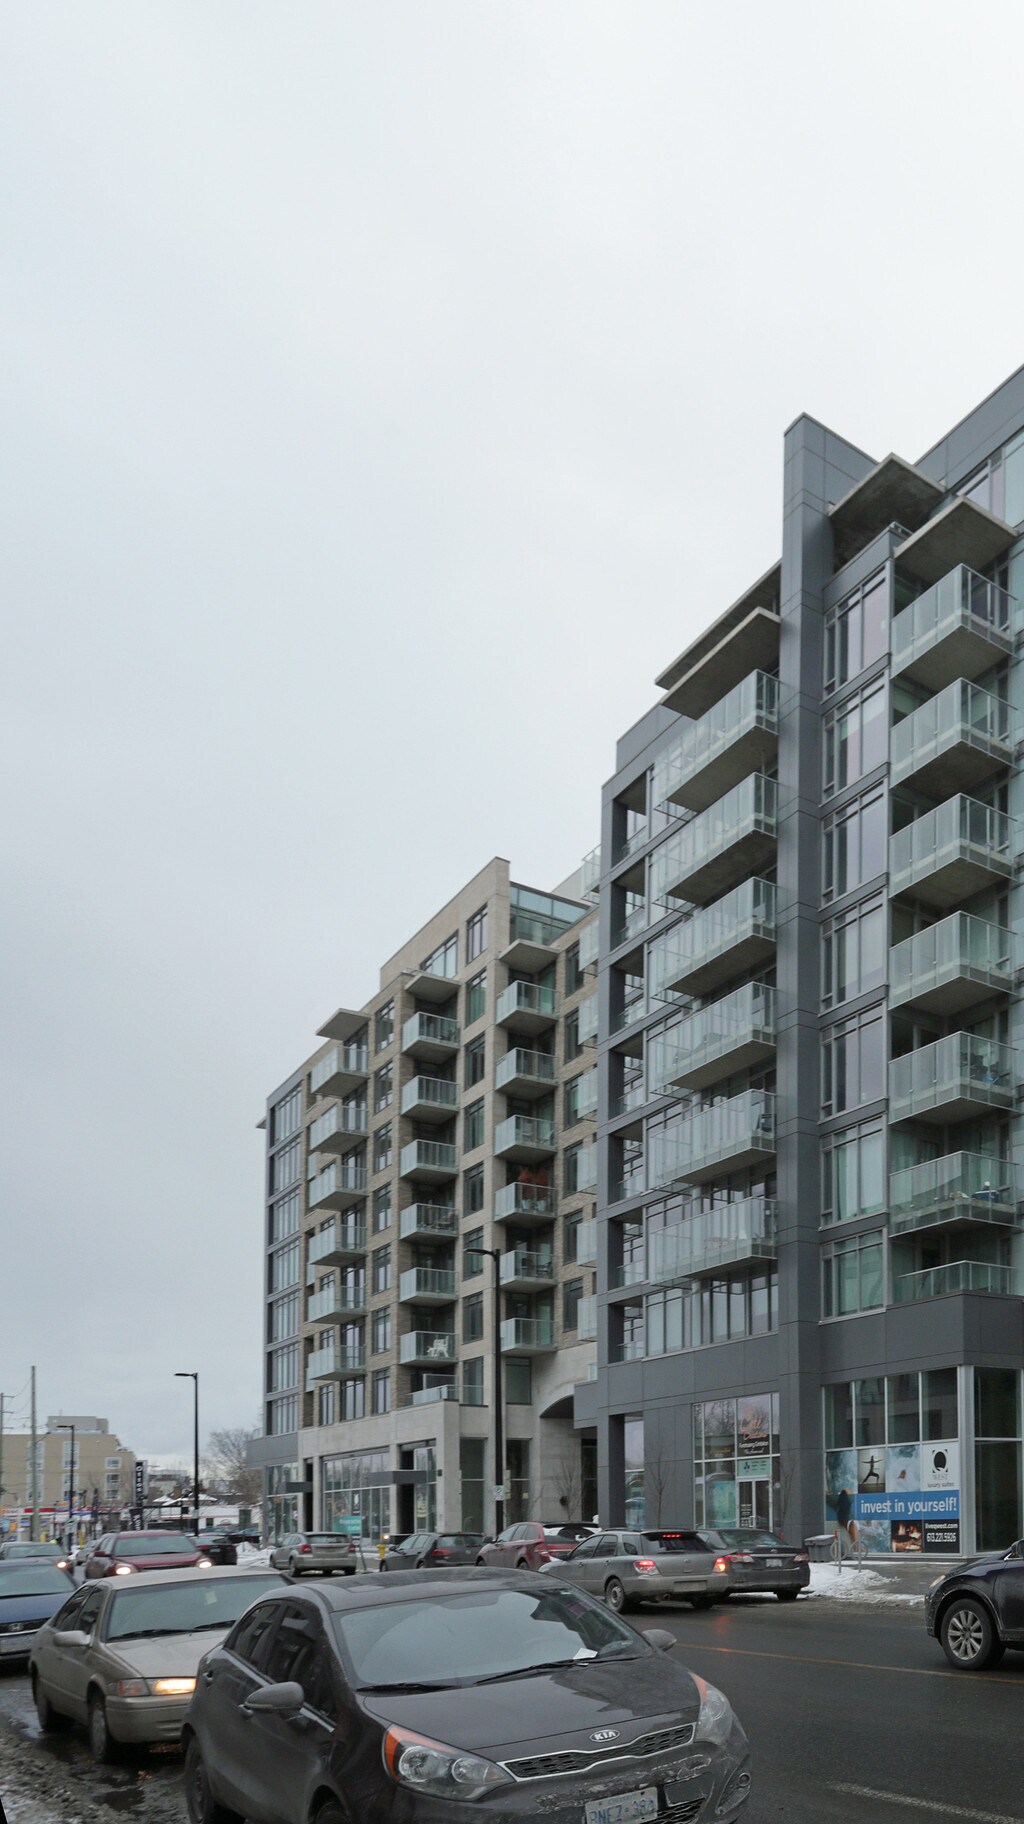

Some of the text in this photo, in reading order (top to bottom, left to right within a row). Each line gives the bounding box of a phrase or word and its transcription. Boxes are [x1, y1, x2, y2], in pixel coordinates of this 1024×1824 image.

[861, 1497, 957, 1515] invest in yourself!
[594, 1731, 616, 1741] KIA
